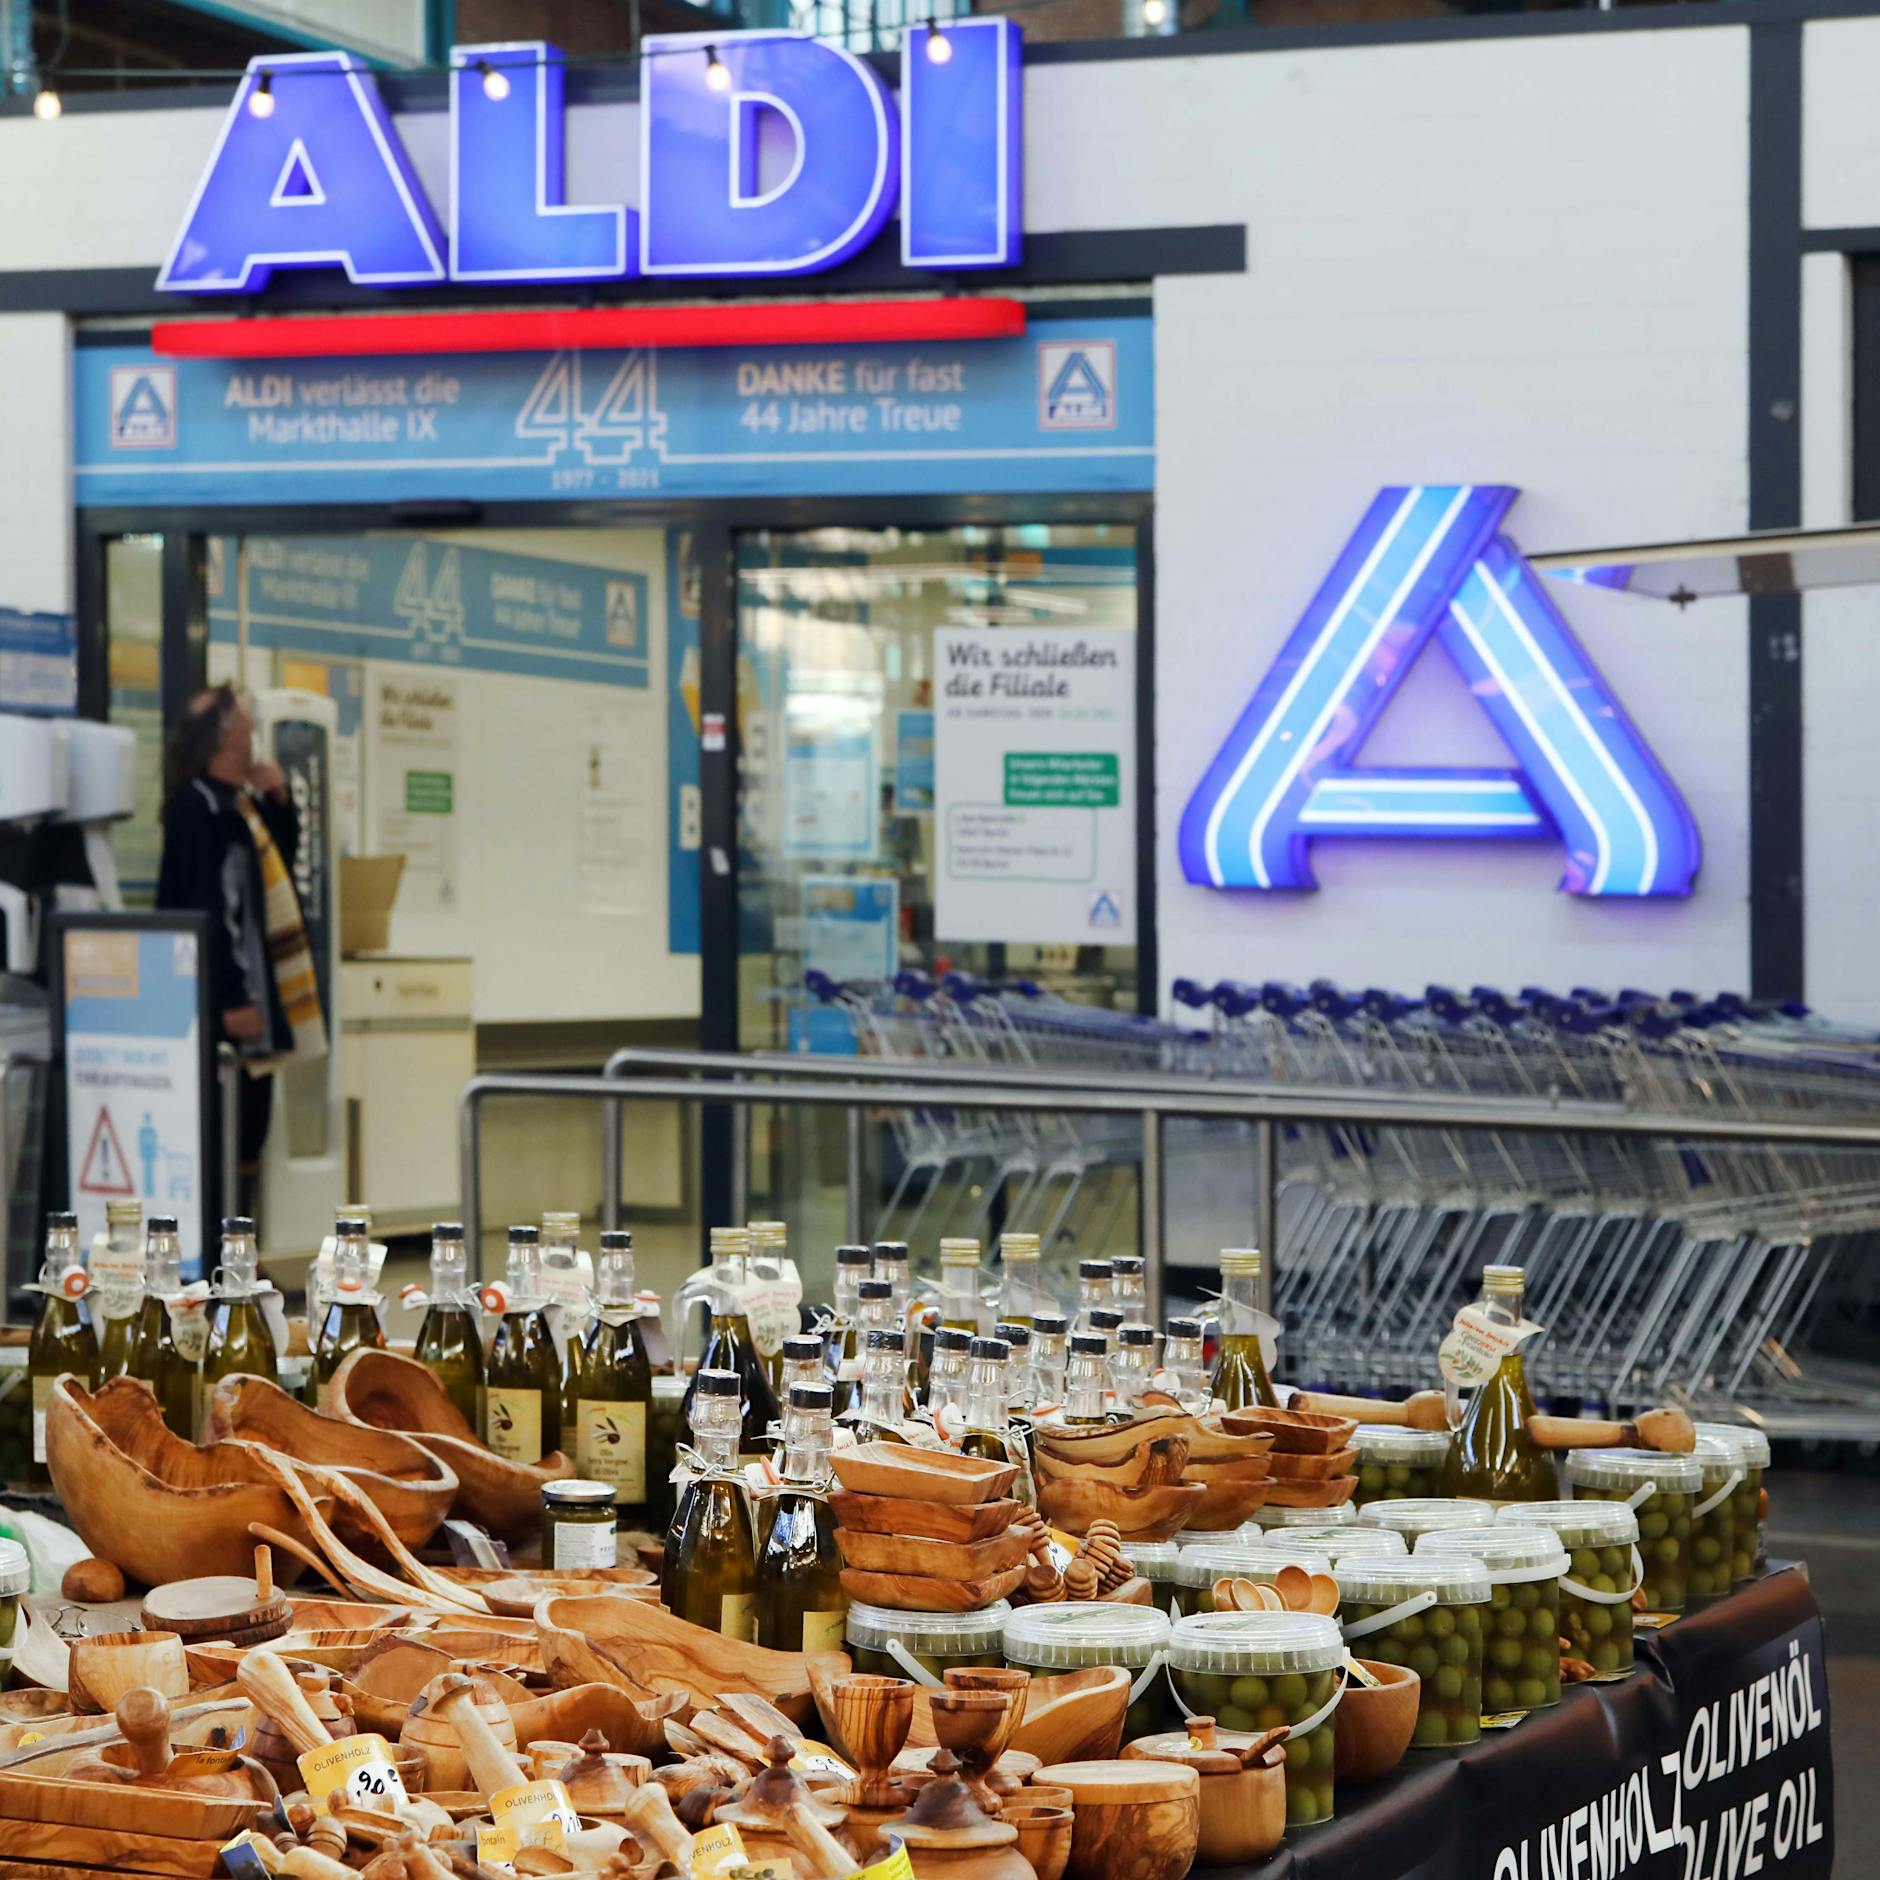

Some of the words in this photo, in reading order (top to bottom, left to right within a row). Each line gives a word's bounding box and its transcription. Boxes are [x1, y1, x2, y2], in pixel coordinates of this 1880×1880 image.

[155, 17, 1022, 293] ALDI
[225, 375, 293, 408] ALDI
[300, 373, 407, 406] verlässt
[415, 370, 461, 405] die
[737, 362, 848, 397] DANKE
[855, 359, 899, 392] für
[907, 358, 965, 393] fast
[514, 346, 668, 463] 44
[740, 400, 782, 433] 44
[787, 400, 869, 434] Jahre
[874, 397, 962, 432] Treue
[248, 409, 400, 444] Markthalle
[406, 408, 439, 441] IX
[947, 641, 992, 667] Wir
[1001, 641, 1118, 668] schließen
[945, 672, 982, 698] die
[990, 671, 1069, 698] Filiale
[1182, 484, 1703, 898] A
[1682, 1639, 1823, 1791] OLIVENÖL
[314, 1746, 372, 1772] OLIVENHOLZ
[1773, 1767, 1824, 1862] OIL
